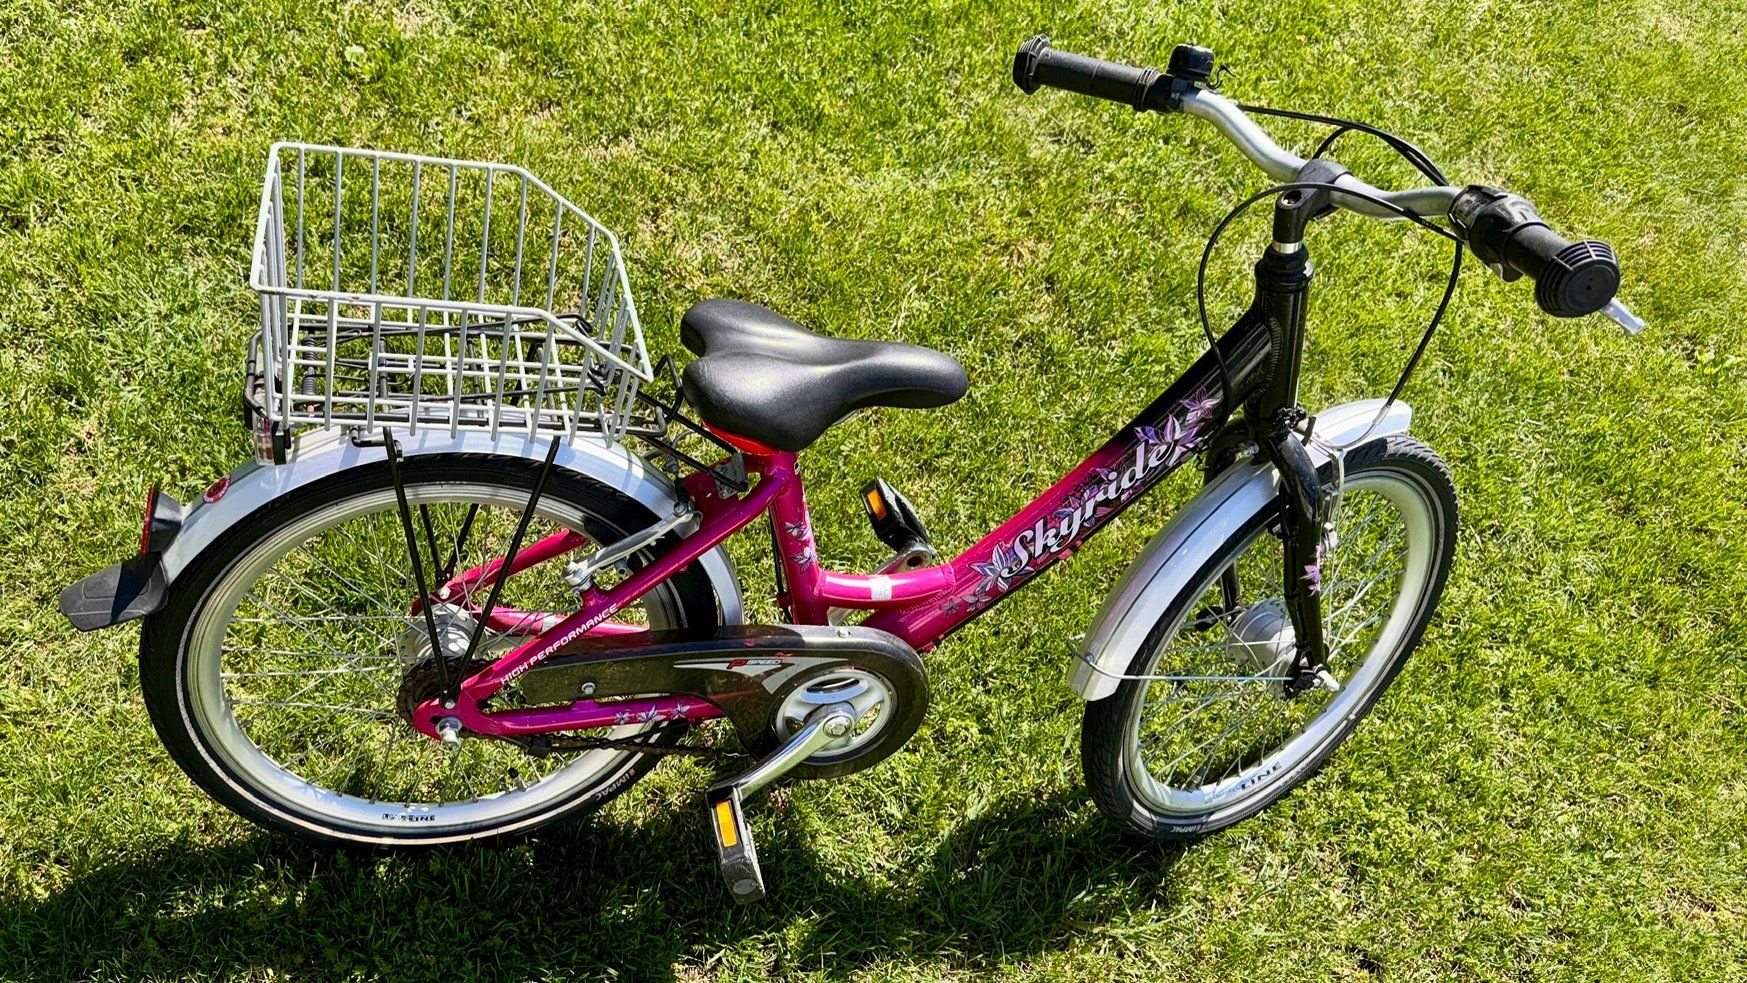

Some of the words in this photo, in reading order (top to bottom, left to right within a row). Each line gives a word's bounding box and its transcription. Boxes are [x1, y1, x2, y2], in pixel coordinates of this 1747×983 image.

[1000, 439, 1175, 577] Skyride
[500, 662, 529, 685] HIGH
[529, 602, 619, 666] PERFORMANCE
[594, 773, 630, 802] IMPAC
